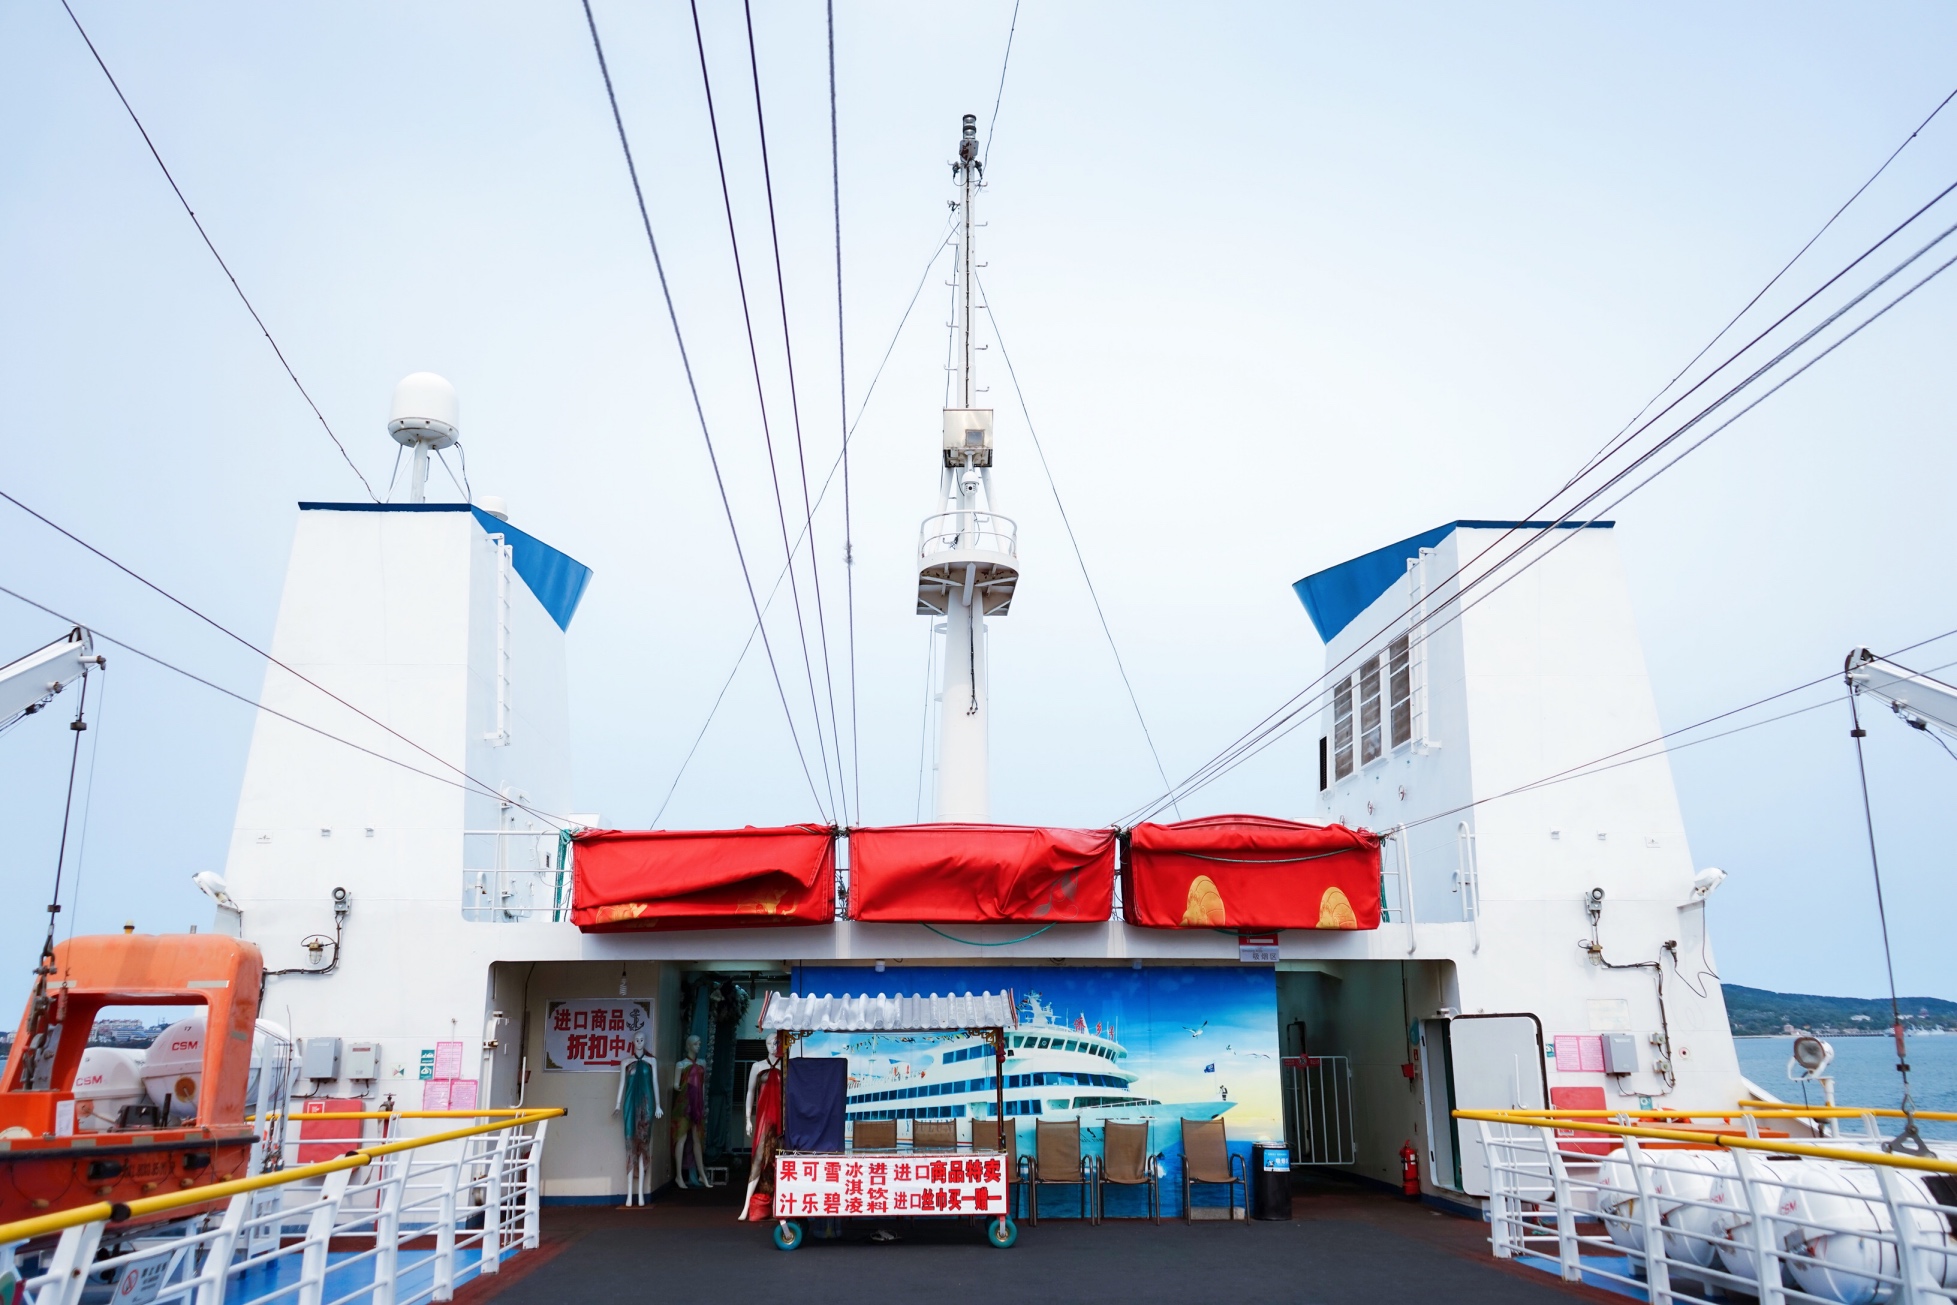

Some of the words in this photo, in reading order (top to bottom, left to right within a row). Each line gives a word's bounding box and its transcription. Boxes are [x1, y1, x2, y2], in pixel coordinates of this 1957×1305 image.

[553, 1008, 625, 1031] 进口商品
[171, 1040, 199, 1052] CSM
[75, 1074, 103, 1087] CSM
[779, 1160, 798, 1215] 果汁
[801, 1161, 820, 1215] 可乐
[823, 1161, 842, 1215] 雪碧
[844, 1161, 864, 1214] 冰淇凌
[866, 1162, 889, 1214] 进口饮料
[893, 1158, 1002, 1184] 进口商品特卖
[893, 1186, 1003, 1212] 进口丝巾买一赠一
